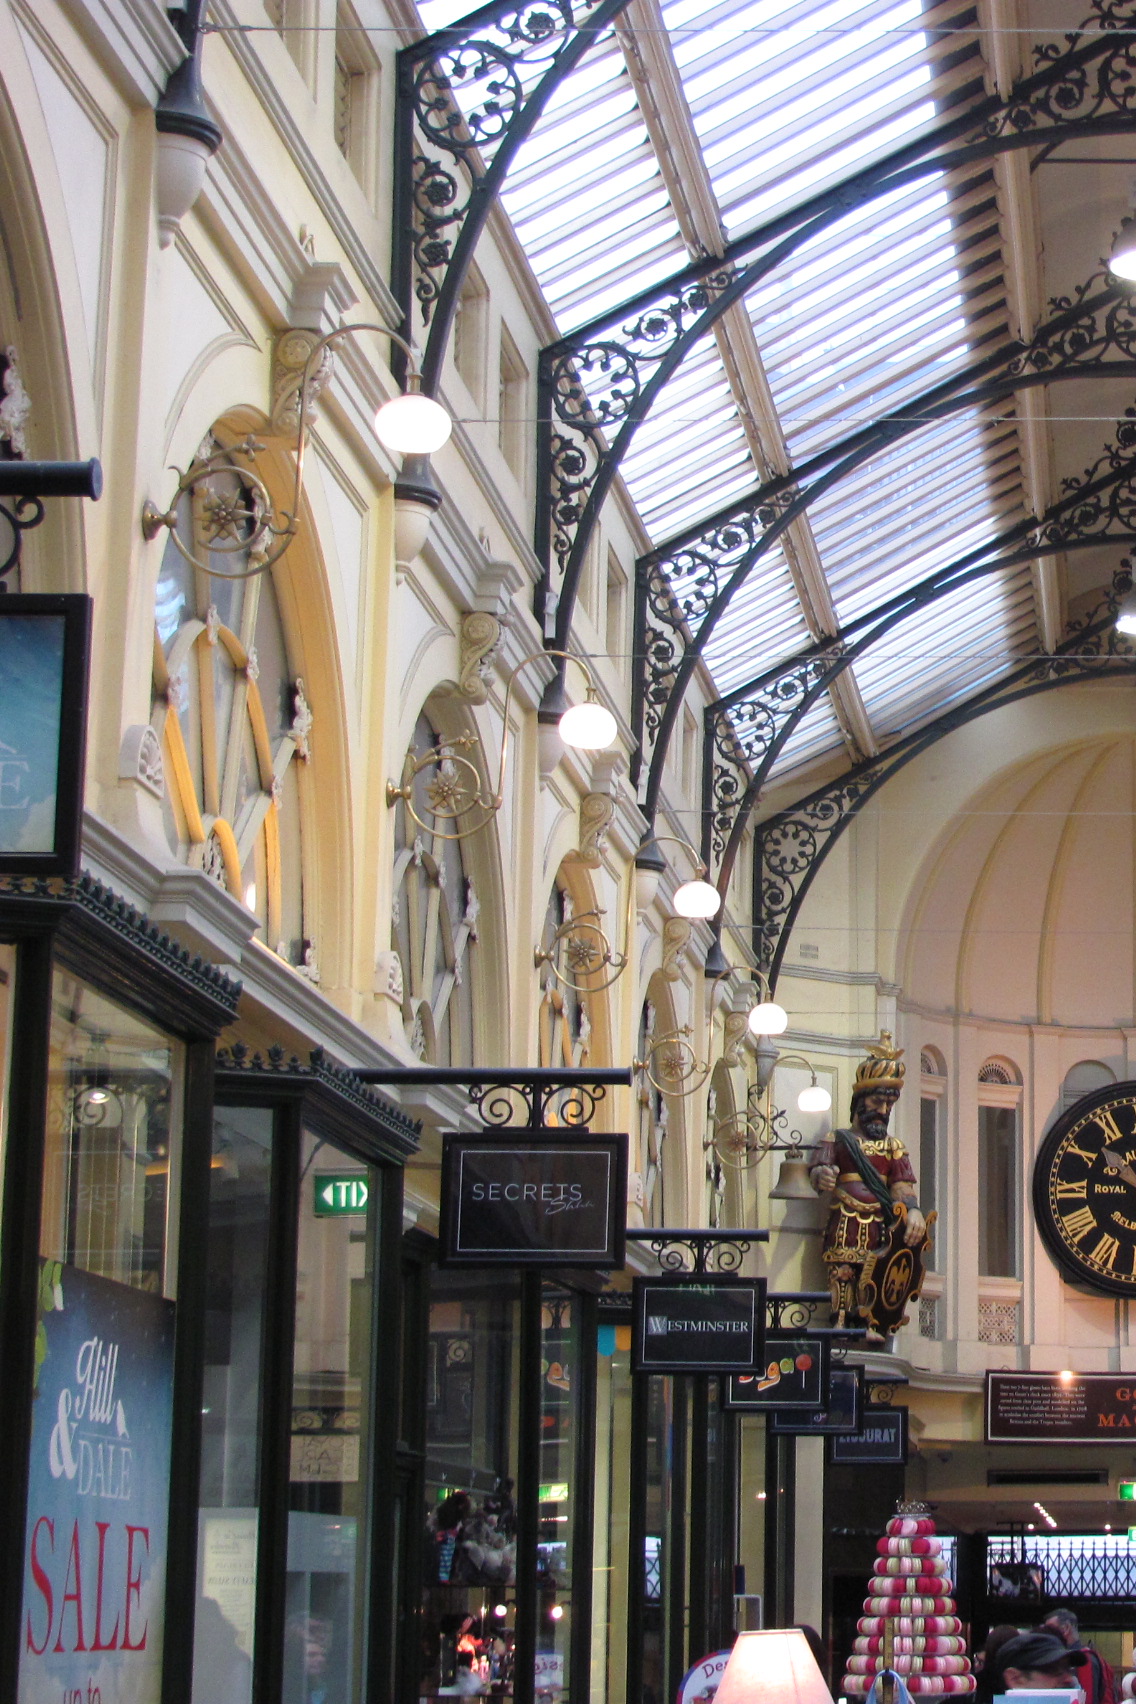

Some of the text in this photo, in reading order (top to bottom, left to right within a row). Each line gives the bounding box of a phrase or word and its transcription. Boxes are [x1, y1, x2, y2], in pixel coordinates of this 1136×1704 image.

[471, 1183, 583, 1201] SECRETS
[1094, 1184, 1127, 1194] ROYAL
[649, 1316, 749, 1333] WESTMINSTER
[75, 1335, 119, 1424] Hill
[50, 1388, 133, 1500] & DALE
[26, 1516, 150, 1655] SALE
